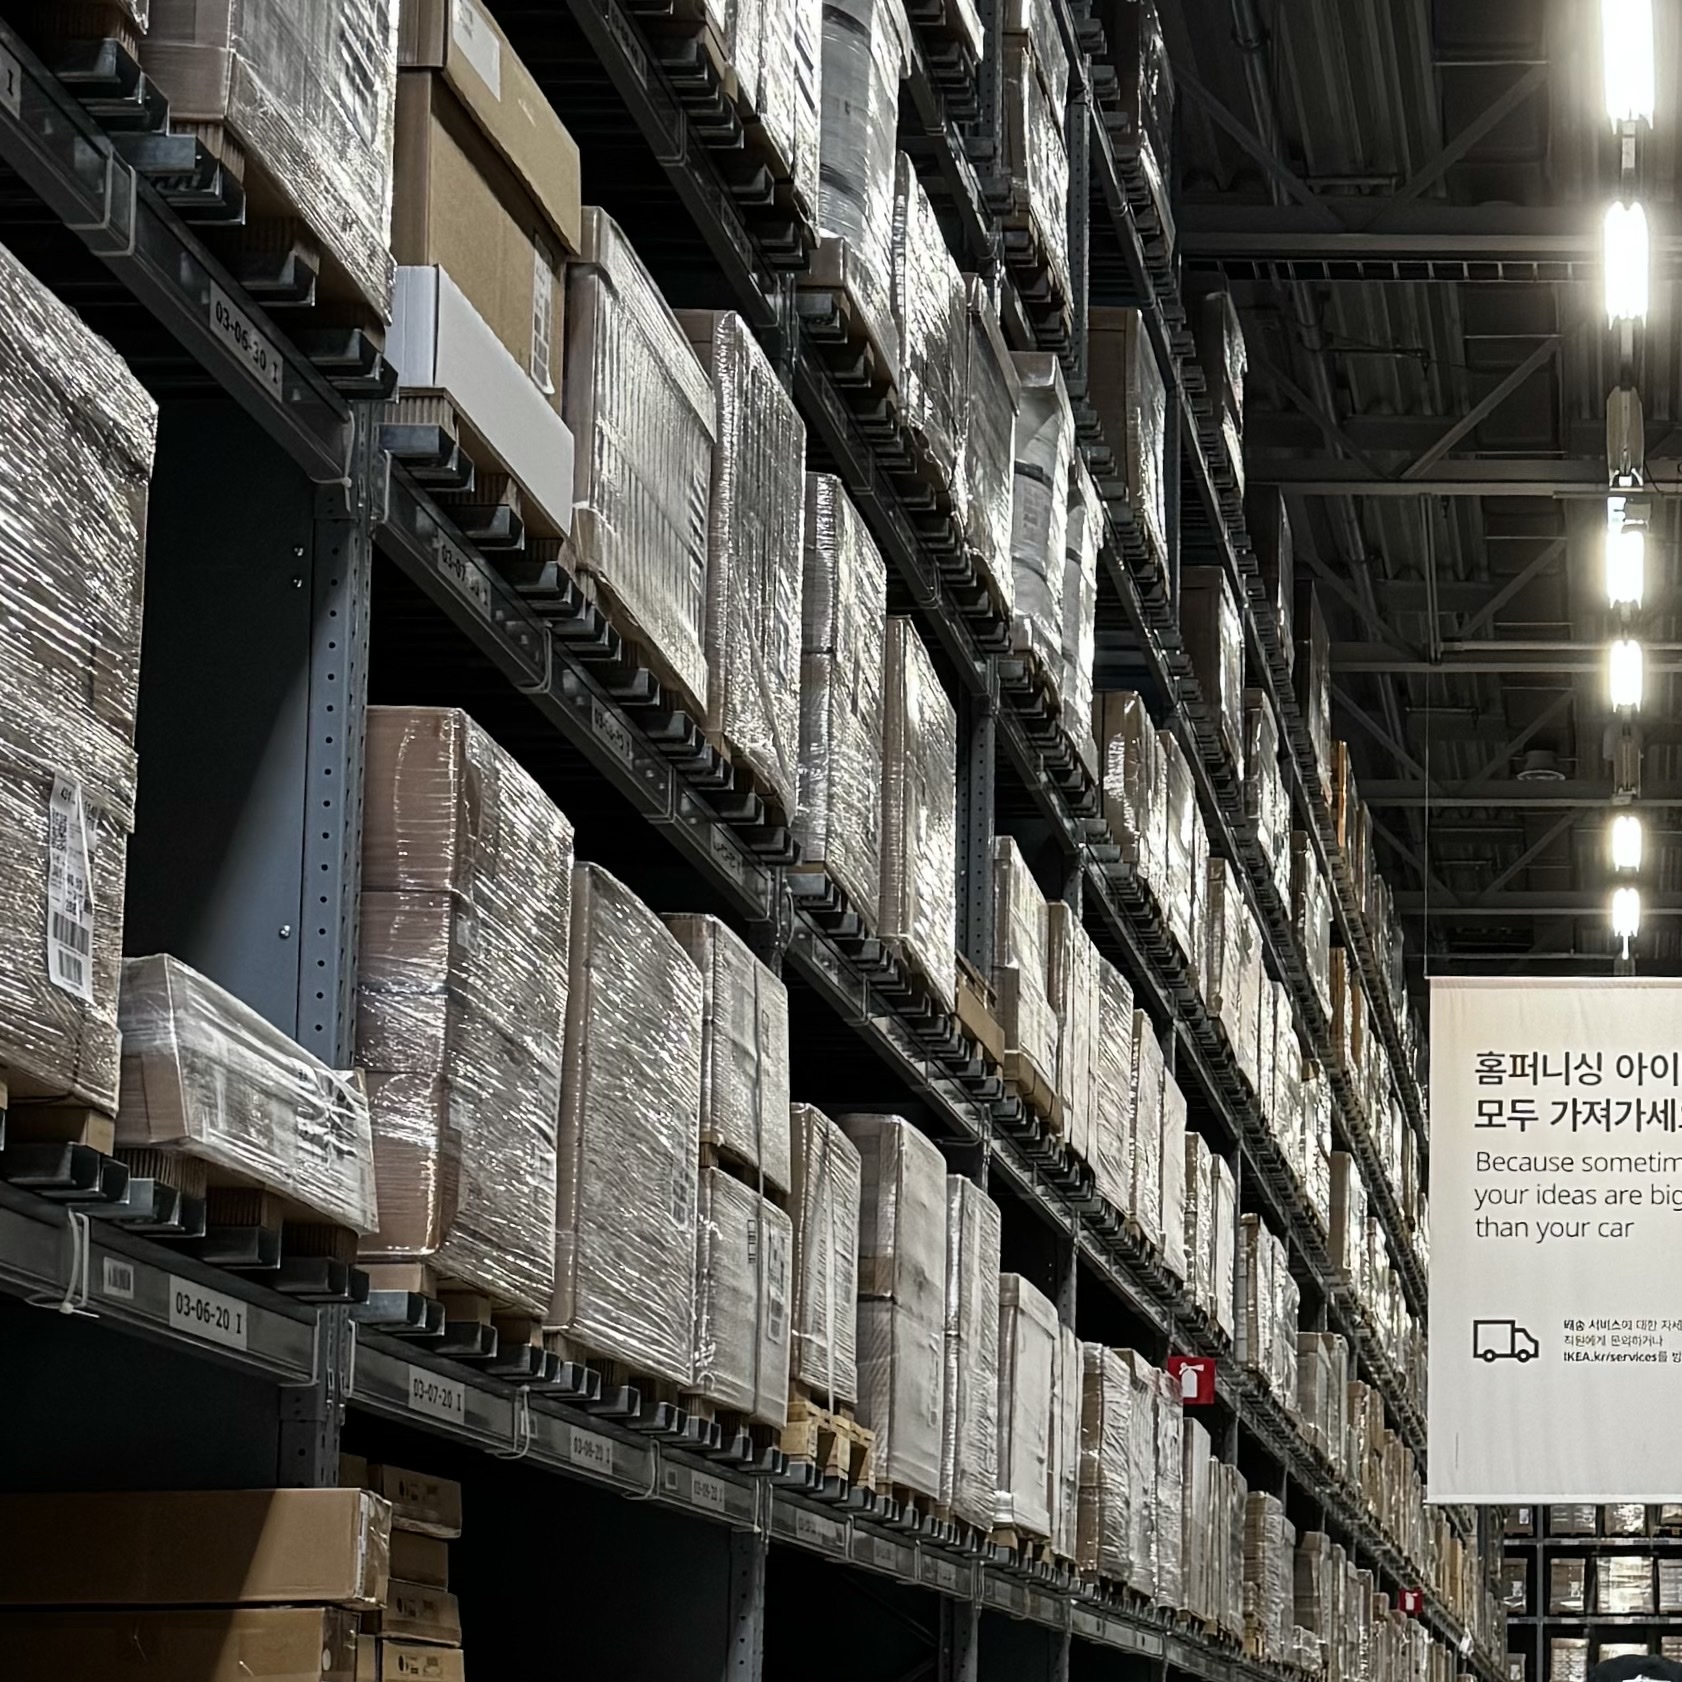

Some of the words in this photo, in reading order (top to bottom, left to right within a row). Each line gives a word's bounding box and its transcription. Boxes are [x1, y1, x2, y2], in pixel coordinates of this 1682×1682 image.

[215, 301, 267, 371] 03-06-30
[1475, 1050, 1603, 1087] 홈퍼니싱
[1474, 1099, 1540, 1132] 모두
[1476, 1150, 1575, 1174] Because
[1474, 1185, 1530, 1211] your
[1536, 1182, 1597, 1206] ideas
[1604, 1187, 1643, 1206] are
[1475, 1216, 1529, 1239] than
[1535, 1219, 1591, 1244] your
[1597, 1220, 1635, 1239] car
[175, 1291, 230, 1330] 03-06-20
[1563, 1319, 1585, 1332] 배송
[1588, 1319, 1633, 1332] 서비스에
[1636, 1319, 1657, 1332] 대한
[413, 1378, 453, 1409] 03-07-20
